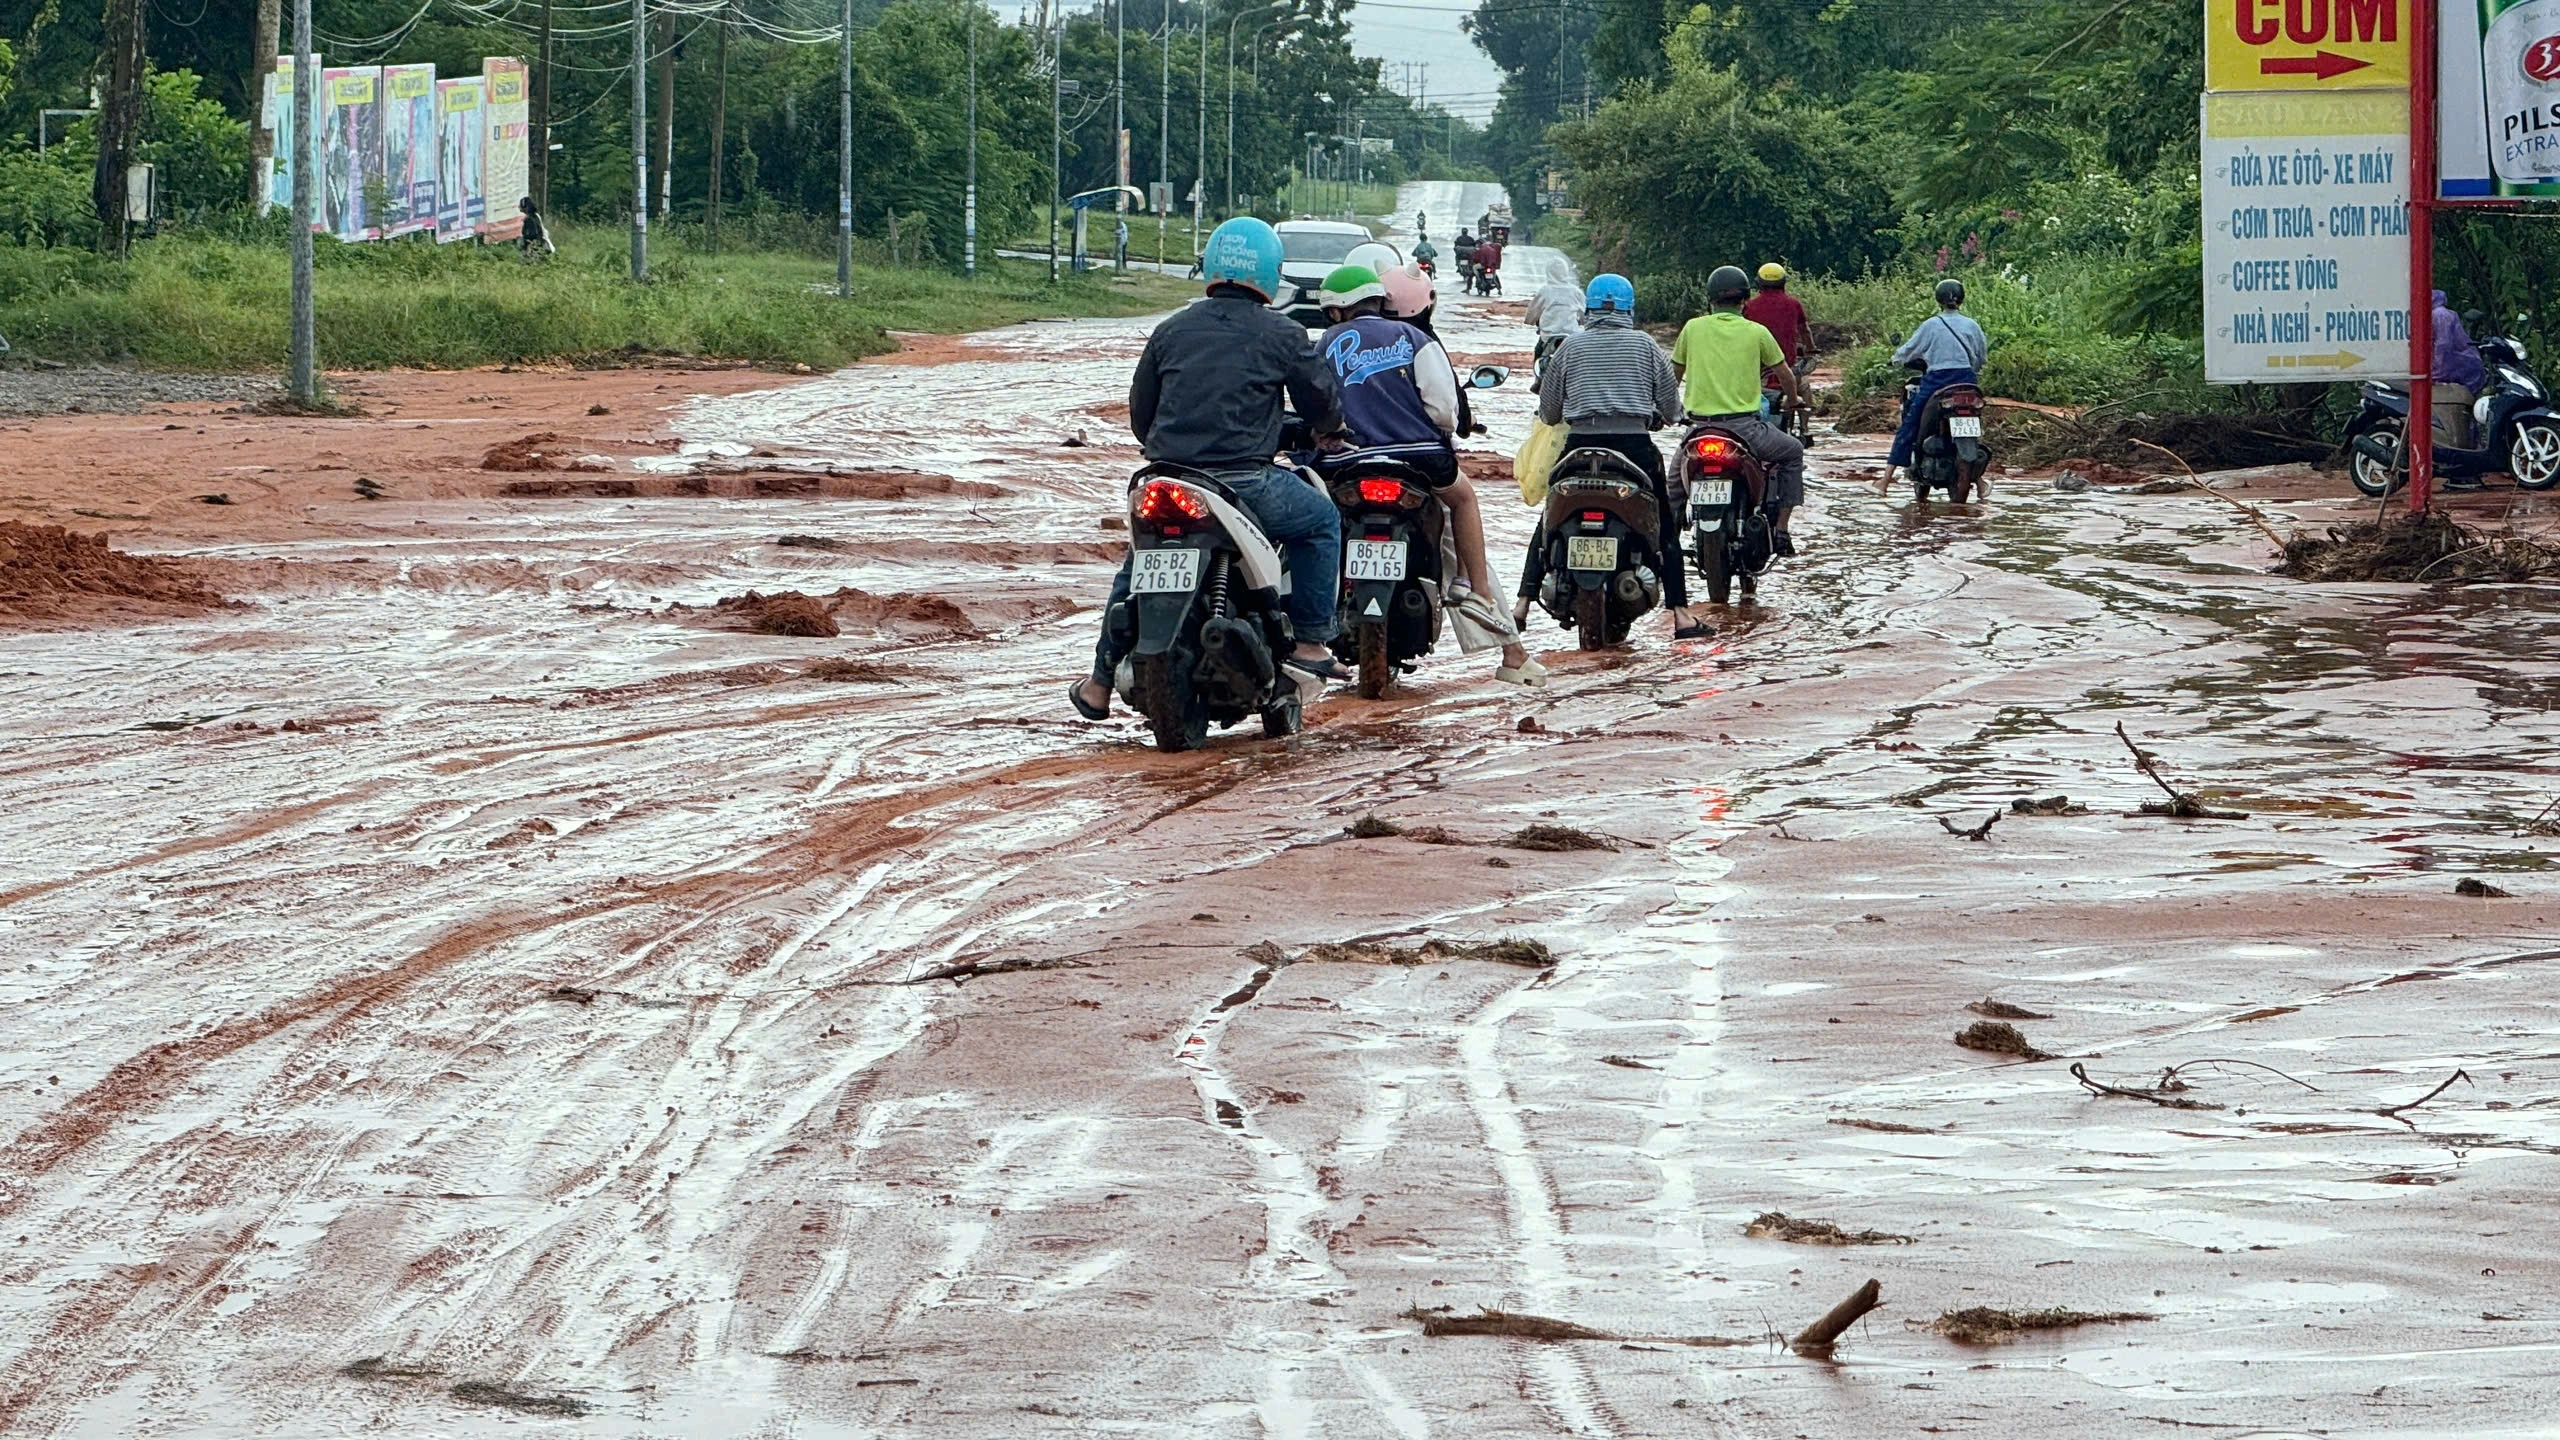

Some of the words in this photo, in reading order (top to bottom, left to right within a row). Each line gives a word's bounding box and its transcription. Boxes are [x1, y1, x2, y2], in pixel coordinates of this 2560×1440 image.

[2506, 133, 2559, 162] EXTRA
[2231, 145, 2263, 187] RỬA
[2268, 155, 2288, 186] XE
[2334, 154, 2354, 184] XE
[2359, 146, 2393, 184] MÁY
[2232, 205, 2268, 239] CƠM
[2273, 204, 2314, 238] TRƯA
[2330, 203, 2365, 237] CƠM
[2233, 260, 2290, 292] COFFEE
[2295, 254, 2338, 290] VÕNG
[2234, 307, 2267, 344] NHÀ
[2272, 302, 2310, 344] NGHỈ
[2326, 303, 2380, 342] PHÒNG
[1325, 329, 1414, 377] Peanuts
[1144, 552, 1188, 570] 86-B2
[1357, 543, 1397, 559] 86-C2
[1135, 571, 1193, 590] 216.16
[1350, 560, 1402, 577] 071.65
